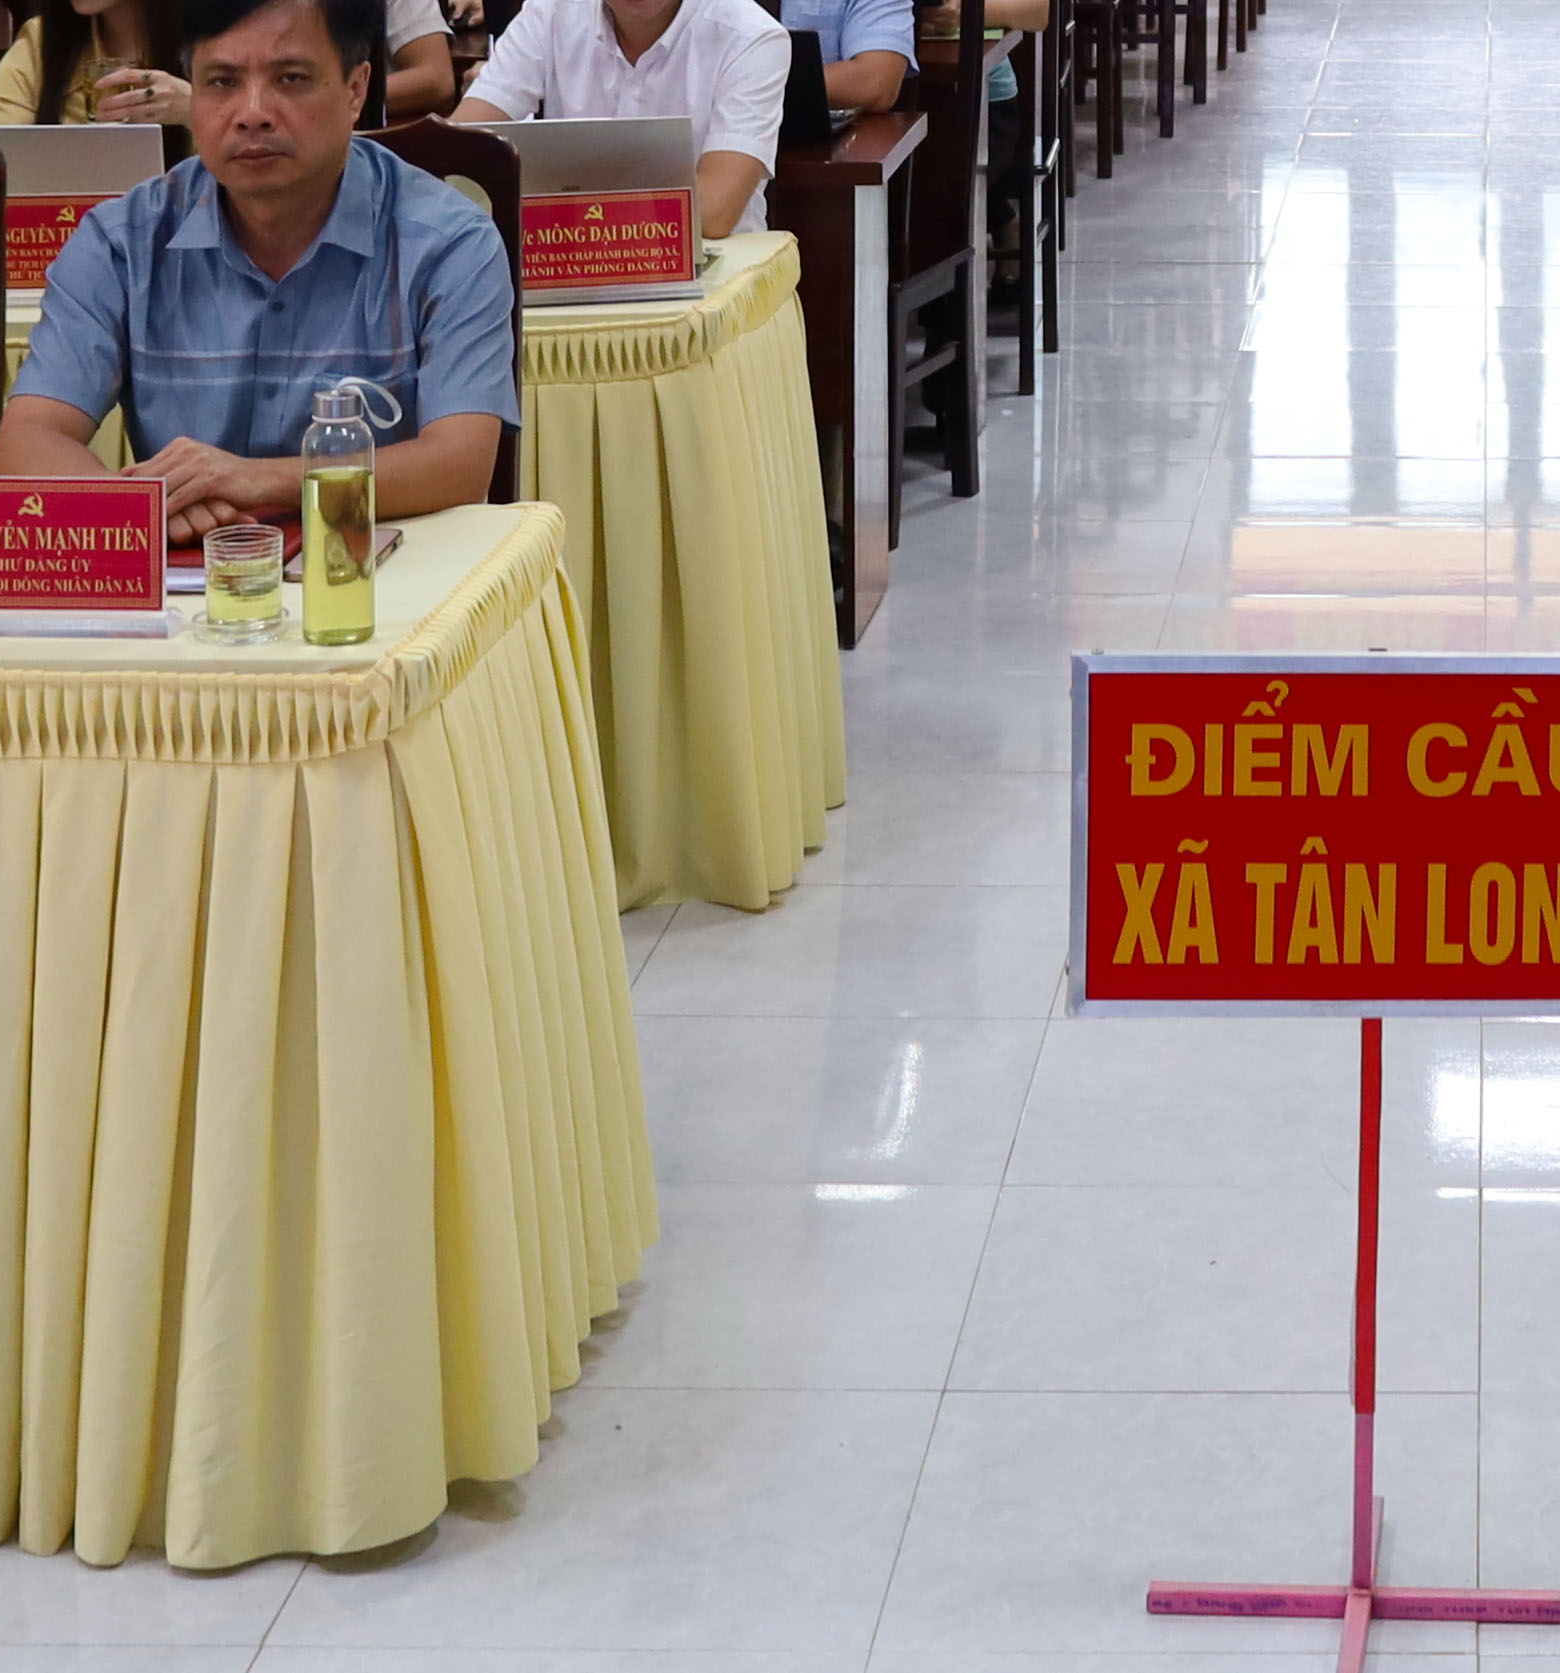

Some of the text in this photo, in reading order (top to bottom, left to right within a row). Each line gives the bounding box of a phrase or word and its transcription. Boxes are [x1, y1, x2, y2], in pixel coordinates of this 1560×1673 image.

[522, 221, 678, 246] /c MÔNG ĐẠI DƯƠNG
[522, 267, 554, 277] HÁNH
[34, 526, 96, 556] MẠNH
[101, 520, 149, 551] TIẾN
[25, 558, 67, 572] ĐẢNG
[71, 555, 91, 572] ỦY
[54, 576, 91, 592] NHÂN
[94, 576, 123, 592] DÂN
[125, 577, 144, 593] XÃ
[1125, 680, 1369, 798] ĐIỂM
[1113, 838, 1219, 965] XÃ
[1246, 836, 1397, 965] TÂN
